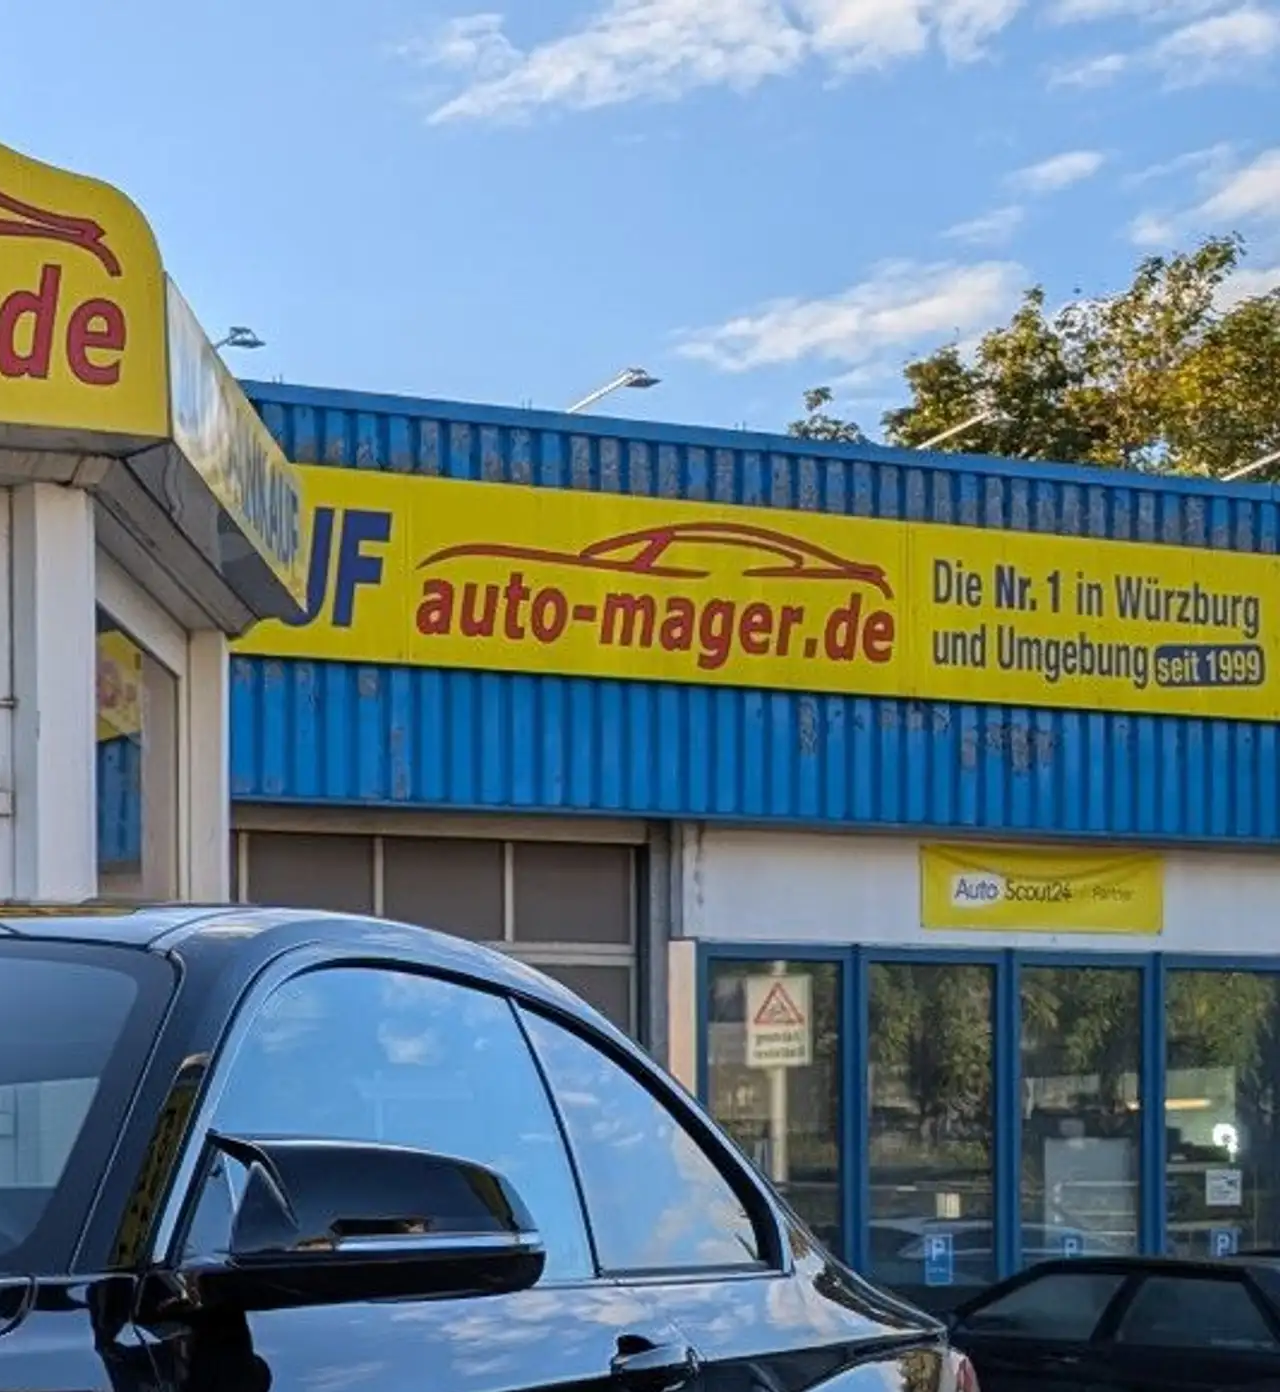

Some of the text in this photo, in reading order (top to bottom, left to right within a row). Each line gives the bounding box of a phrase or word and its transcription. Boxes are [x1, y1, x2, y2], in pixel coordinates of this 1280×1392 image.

[415, 572, 895, 671] auto-mager.de
[933, 559, 1260, 639] Die Nr. 1 in Würzburg
[933, 624, 1260, 690] und Umgebung seit 1999
